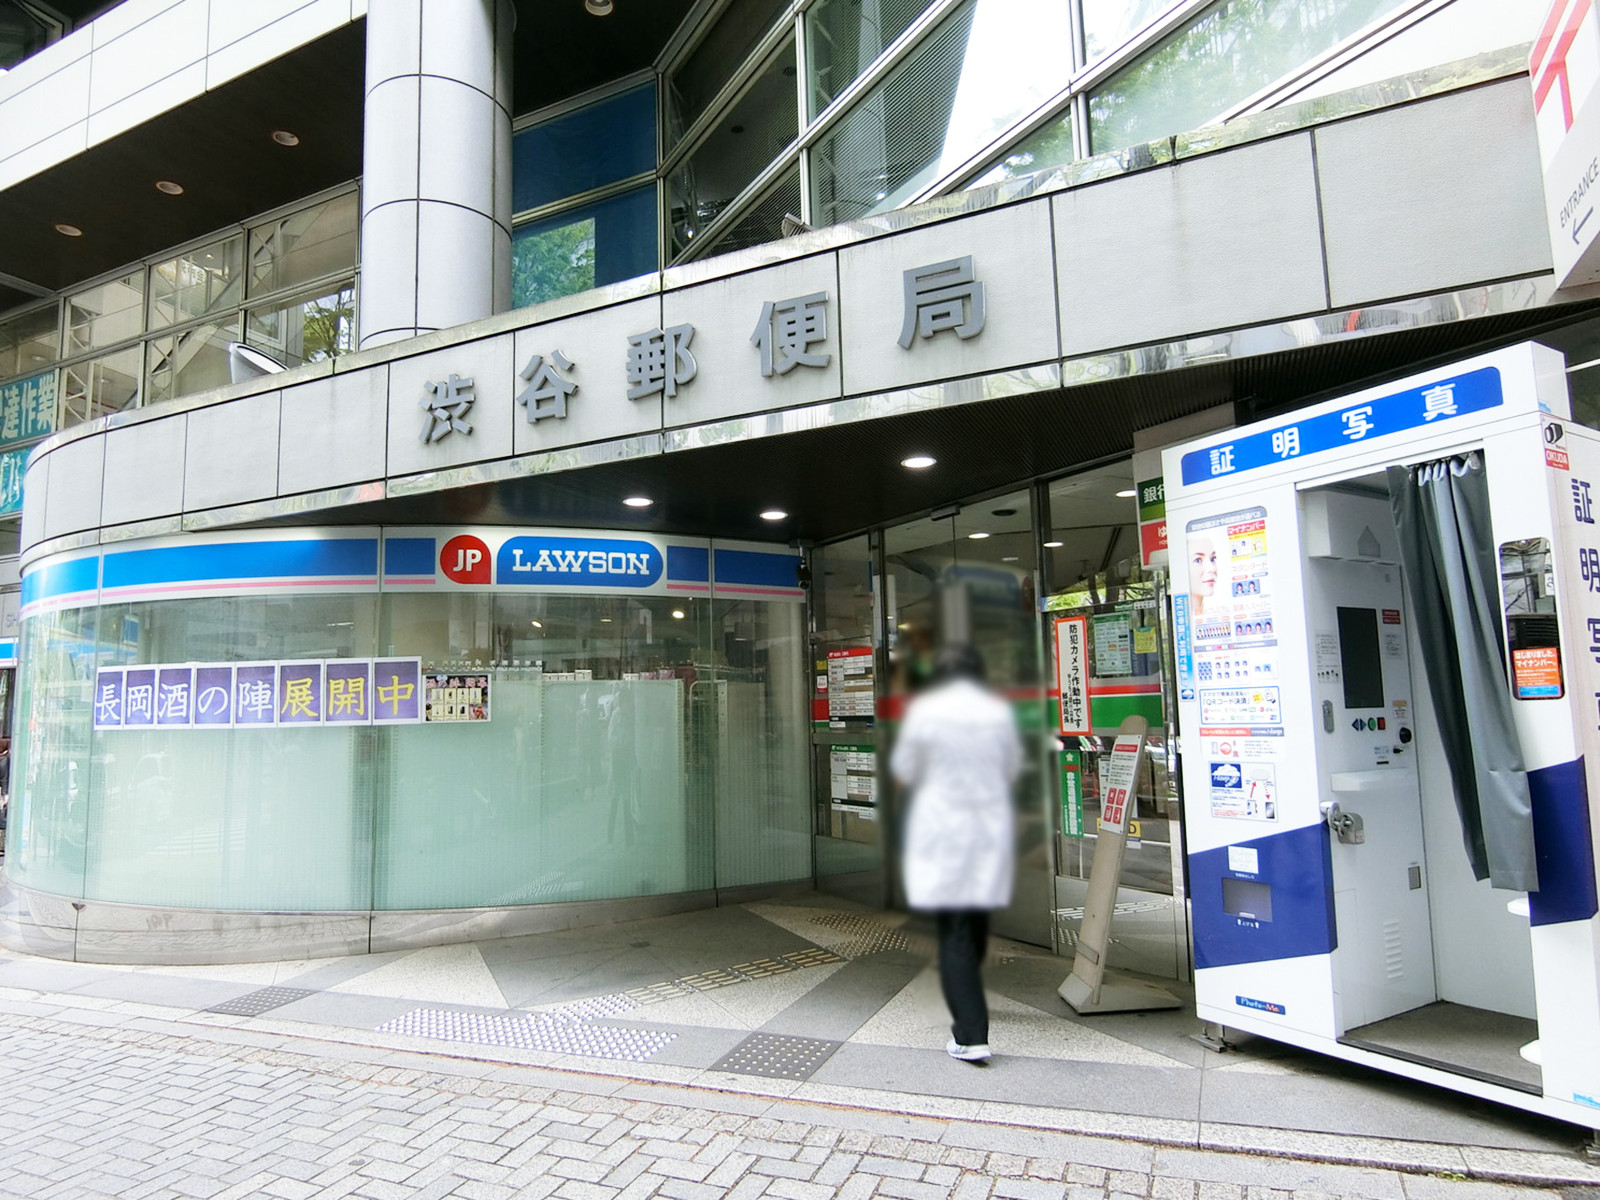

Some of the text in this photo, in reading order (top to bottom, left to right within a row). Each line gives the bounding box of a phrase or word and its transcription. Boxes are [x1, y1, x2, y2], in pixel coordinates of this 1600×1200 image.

[1559, 156, 1599, 228] ENTRANCE
[418, 253, 987, 444] 渋谷郵便局
[0, 373, 54, 439] 達作業
[1209, 383, 1458, 476] 証明写真
[453, 549, 650, 575] JP LAWSON
[1228, 521, 1265, 536] マイナンバー
[95, 675, 415, 723] 長岡酒の陣展開中
[1069, 624, 1082, 729] 防犯カメラ作動中です
